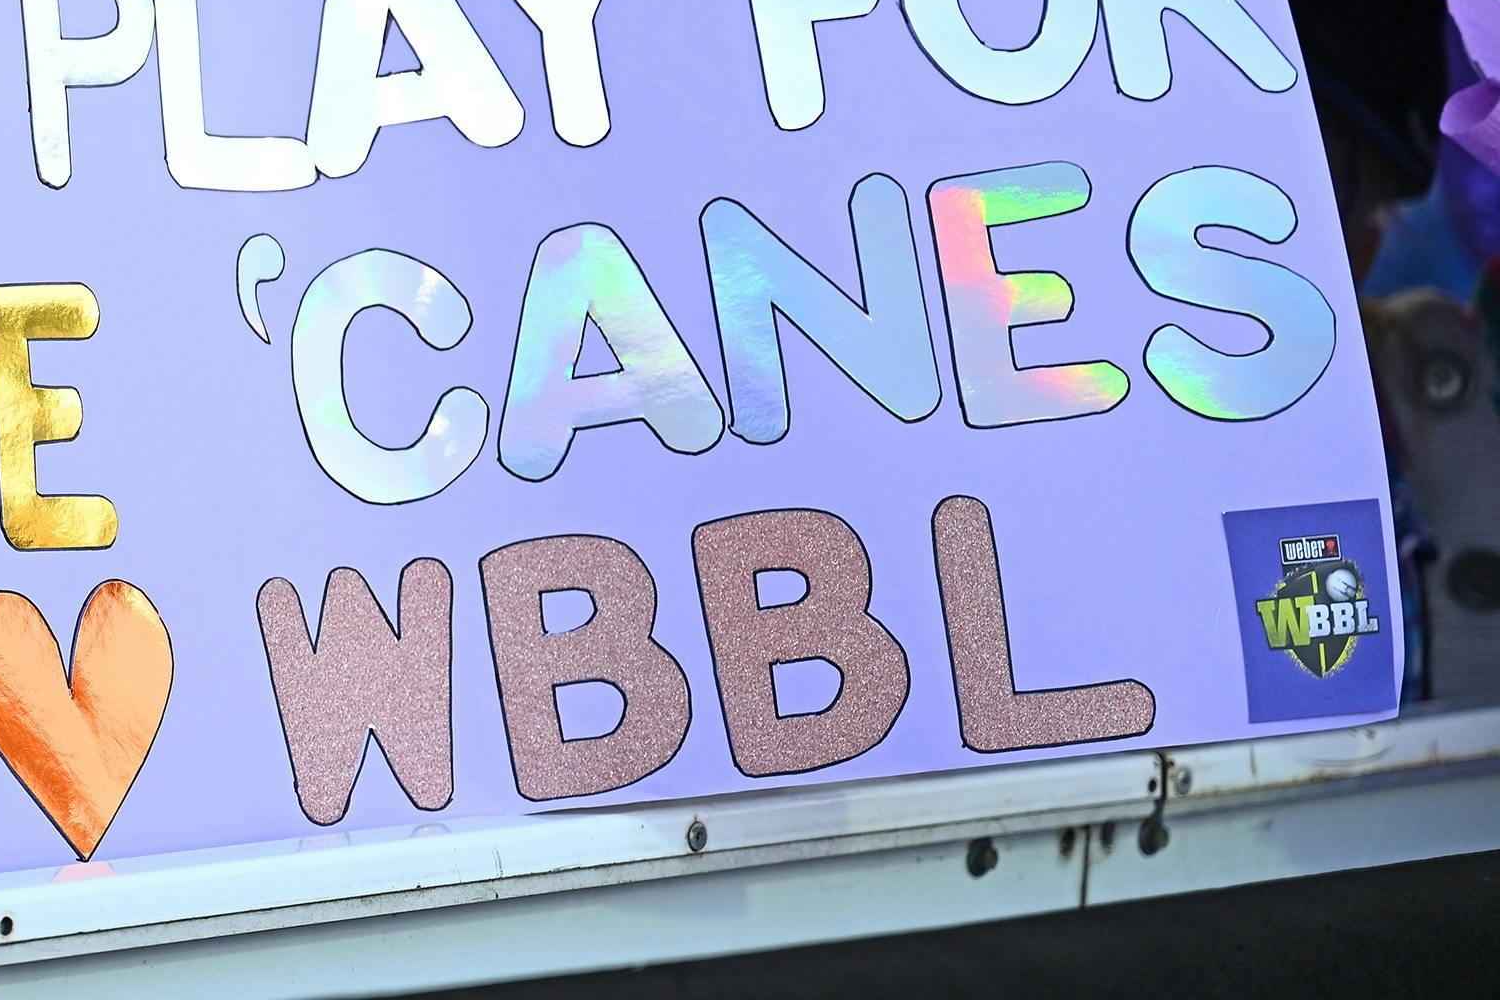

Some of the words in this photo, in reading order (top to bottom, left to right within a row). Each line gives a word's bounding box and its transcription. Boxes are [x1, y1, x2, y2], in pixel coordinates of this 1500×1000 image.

[1284, 537, 1326, 561] weber
[1256, 594, 1379, 649] WBBL
[256, 494, 1157, 827] WBBL
